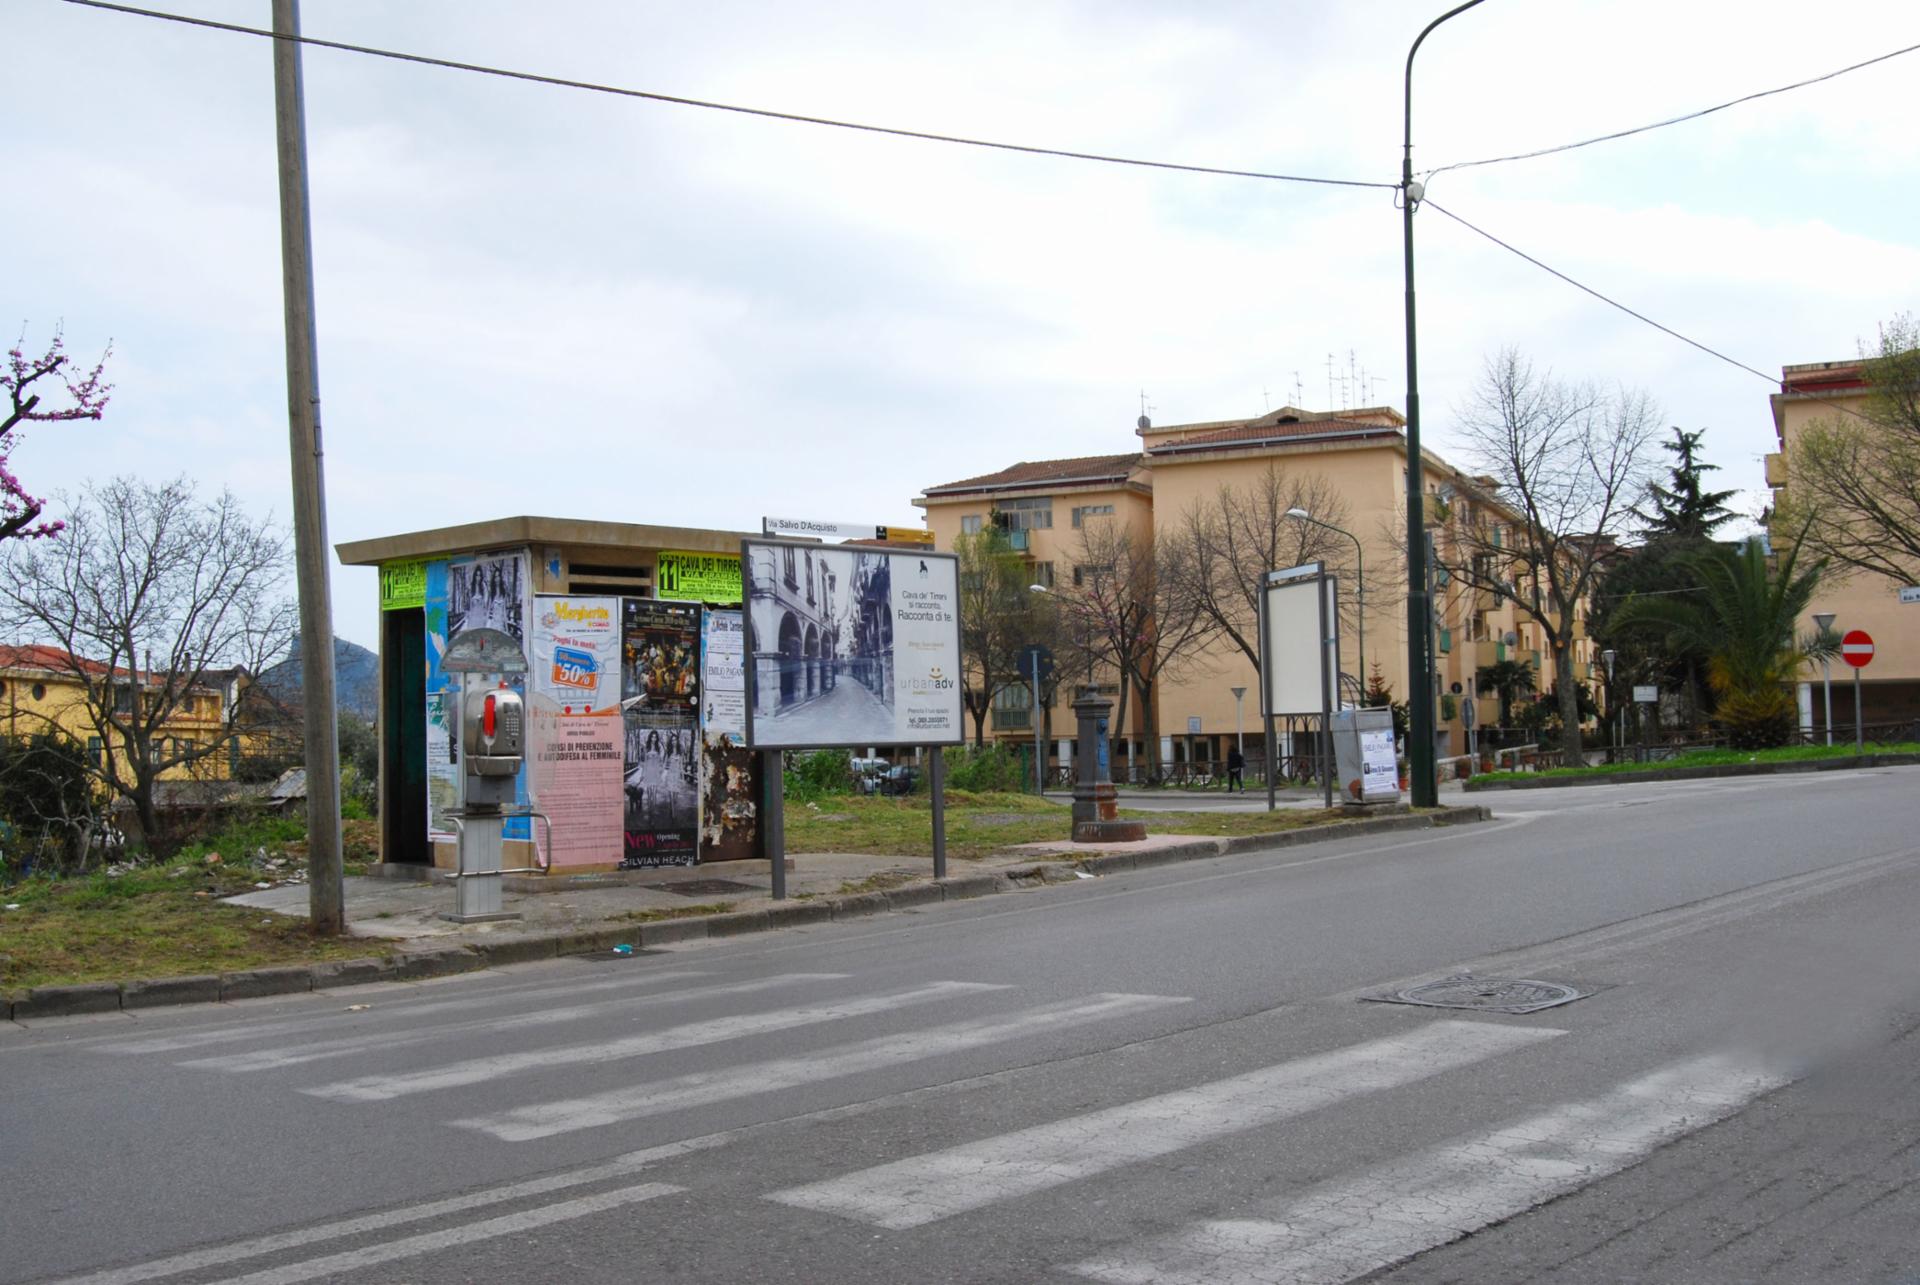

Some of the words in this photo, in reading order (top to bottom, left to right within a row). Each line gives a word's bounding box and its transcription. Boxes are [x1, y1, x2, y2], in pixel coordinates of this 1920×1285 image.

[768, 519, 778, 527] Via
[779, 519, 799, 529] Salvo
[800, 521, 838, 533] D'Acquisto
[681, 556, 700, 570] CAVA
[703, 557, 713, 571] DEI
[716, 558, 742, 573] TIRREN
[660, 560, 678, 591] 11
[703, 572, 741, 580] GRAMSC
[902, 590, 918, 600] Cava
[555, 602, 609, 620] Margherita
[898, 609, 934, 621] Racconta
[935, 612, 942, 622] di
[726, 666, 744, 677] PAGAN
[900, 677, 953, 690] urbanadv
[547, 743, 566, 752] CORSI
[567, 742, 574, 751] DI
[575, 742, 613, 751] PREVENZIONE
[544, 752, 580, 761] AUTODIFESA
[581, 752, 588, 760] AL
[590, 751, 621, 760] FEMMINILE
[625, 831, 656, 849] New
[623, 857, 660, 866] SILVIAN
[662, 856, 694, 866] HEACH
